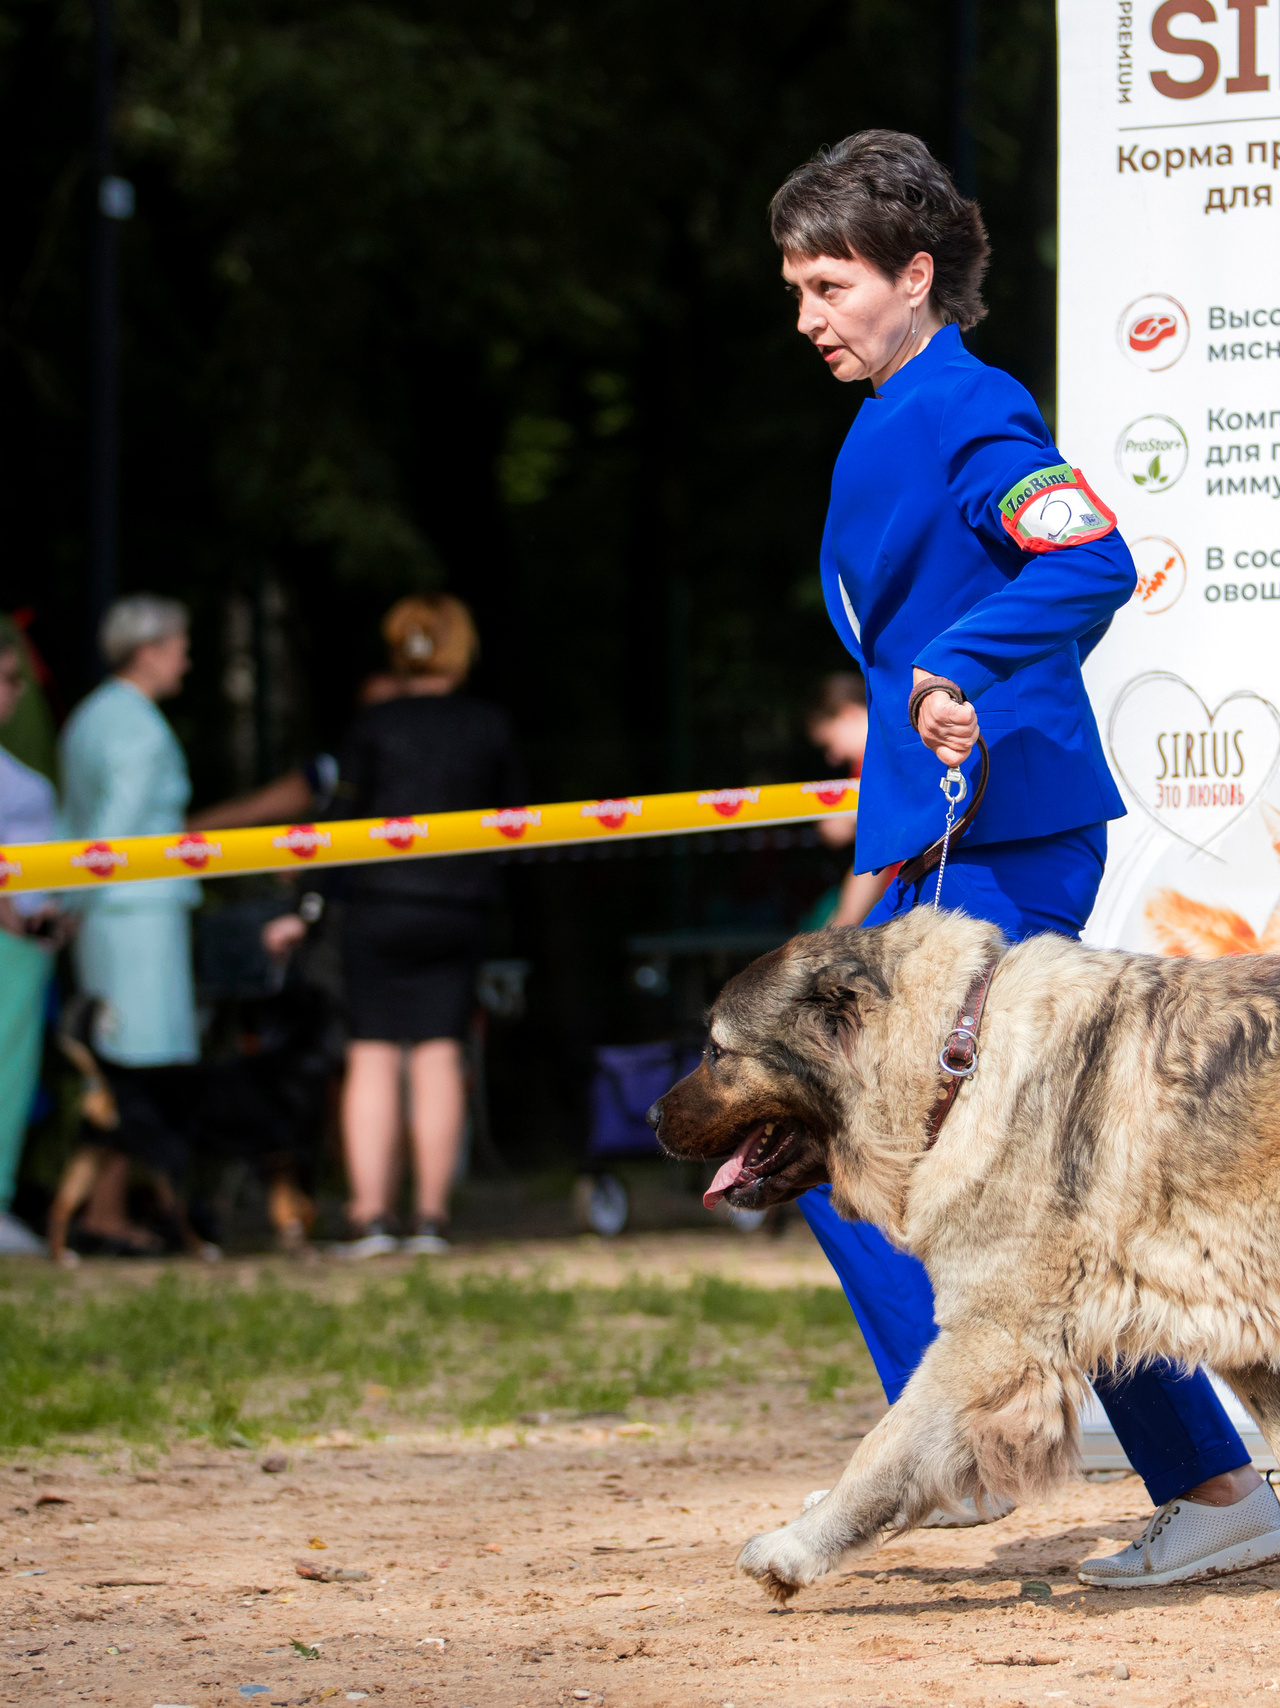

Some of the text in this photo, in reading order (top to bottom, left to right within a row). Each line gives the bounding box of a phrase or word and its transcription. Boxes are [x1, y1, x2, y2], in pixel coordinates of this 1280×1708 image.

[1118, 1, 1133, 104] PREMIUM
[1117, 143, 1233, 178] Корма
[1205, 184, 1272, 215] для
[1205, 444, 1260, 468] для
[1206, 547, 1224, 569] В
[1156, 730, 1245, 780] SIRIUS
[1155, 784, 1245, 808] ЭТО ЛЮБОВЬ
